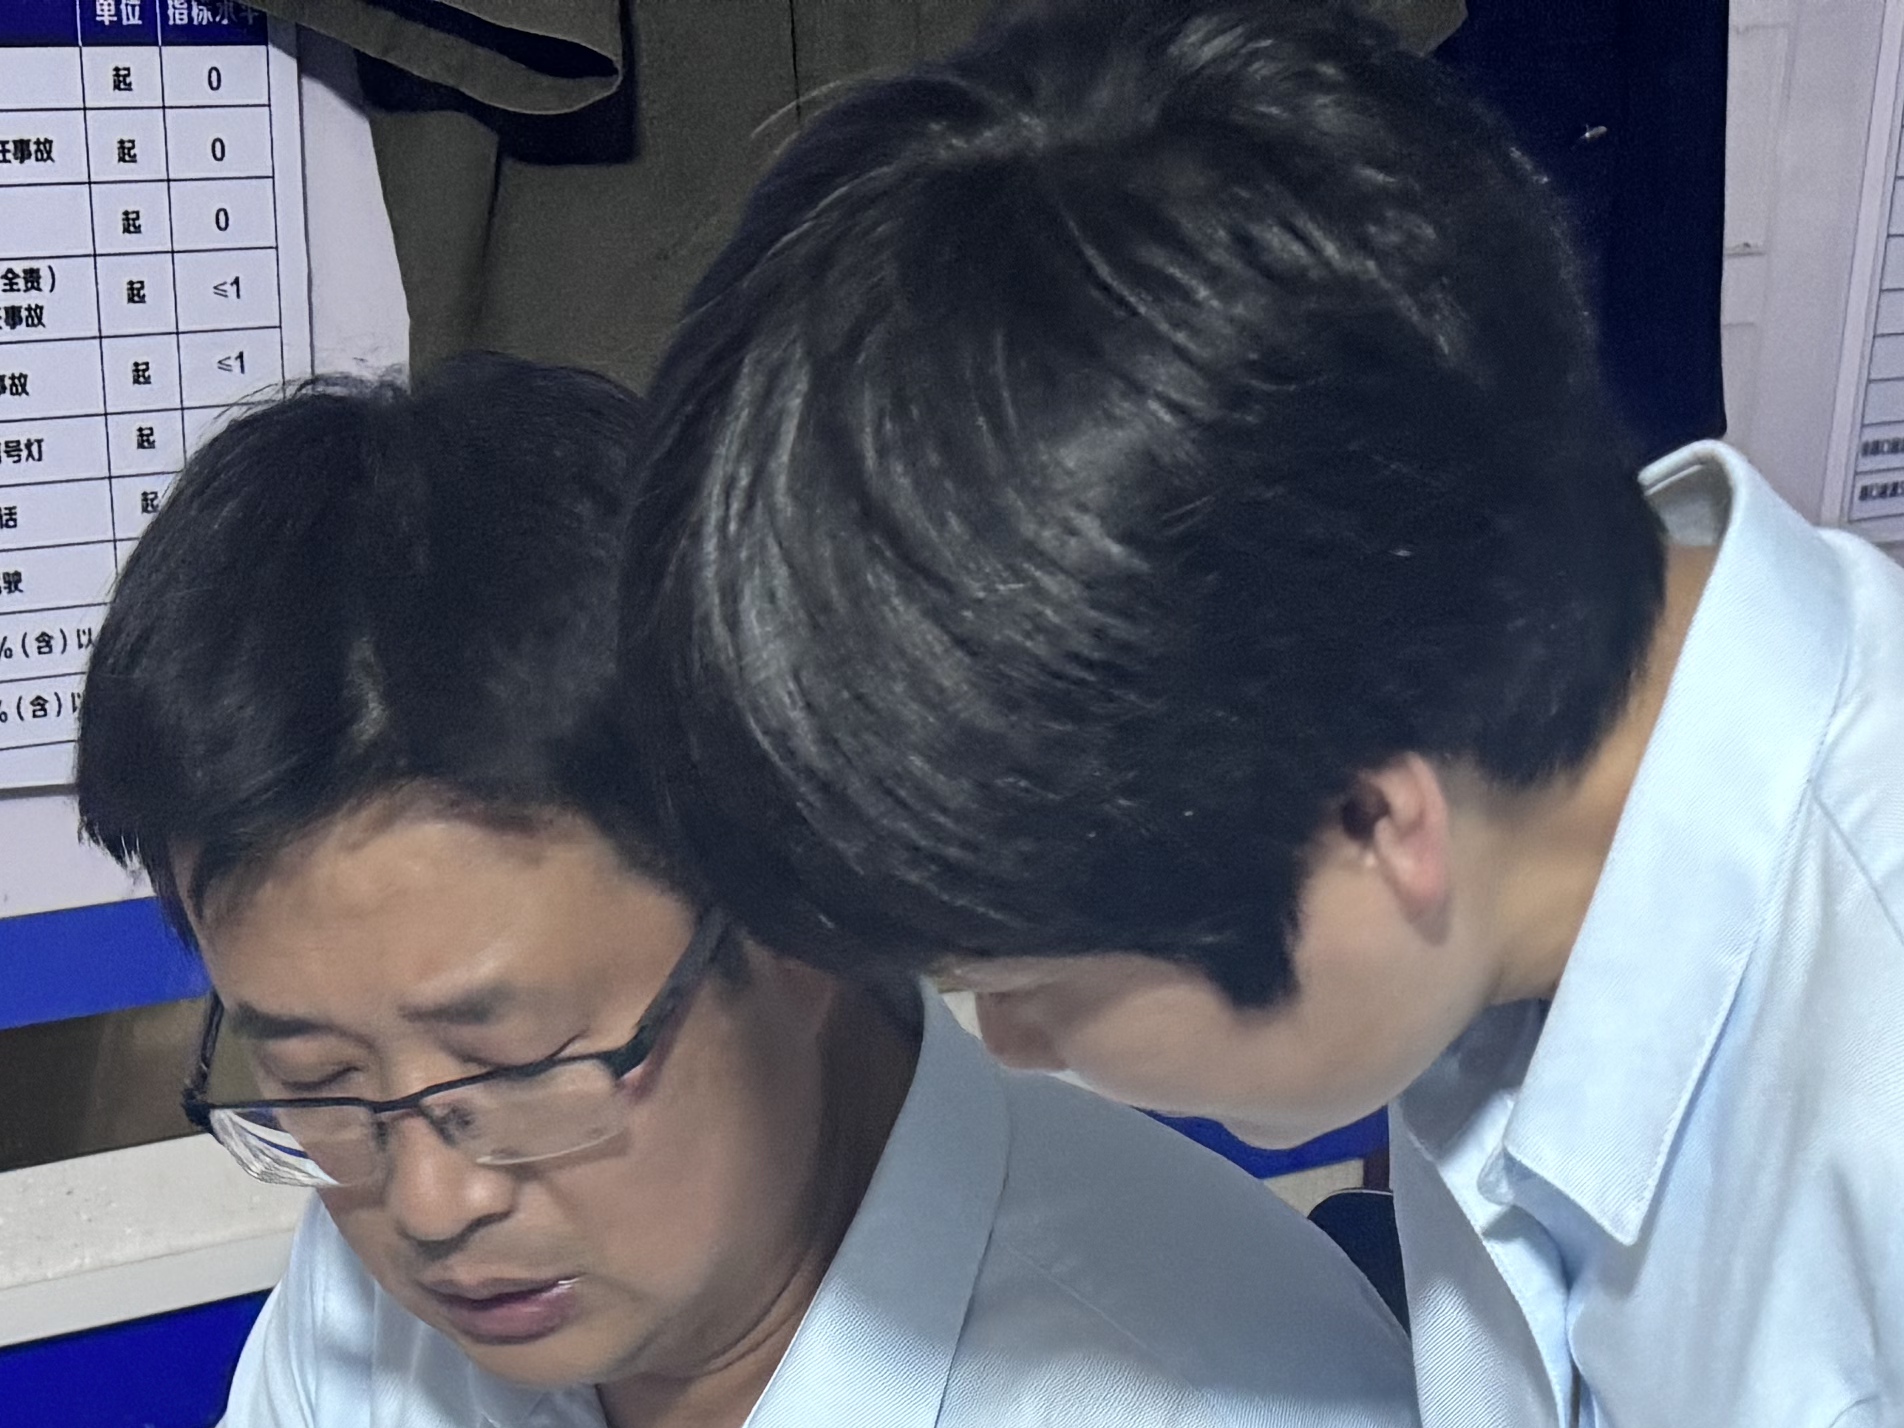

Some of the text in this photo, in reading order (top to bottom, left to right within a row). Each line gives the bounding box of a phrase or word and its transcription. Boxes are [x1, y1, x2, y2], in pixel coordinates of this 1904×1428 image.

[113, 67, 133, 93] 起
[207, 67, 222, 92] 0
[117, 138, 138, 164] 起
[211, 137, 227, 163] 0
[122, 211, 143, 235] 起
[216, 207, 230, 232] 0
[127, 280, 147, 305] 起
[132, 361, 152, 385] 起
[136, 426, 156, 450] 起
